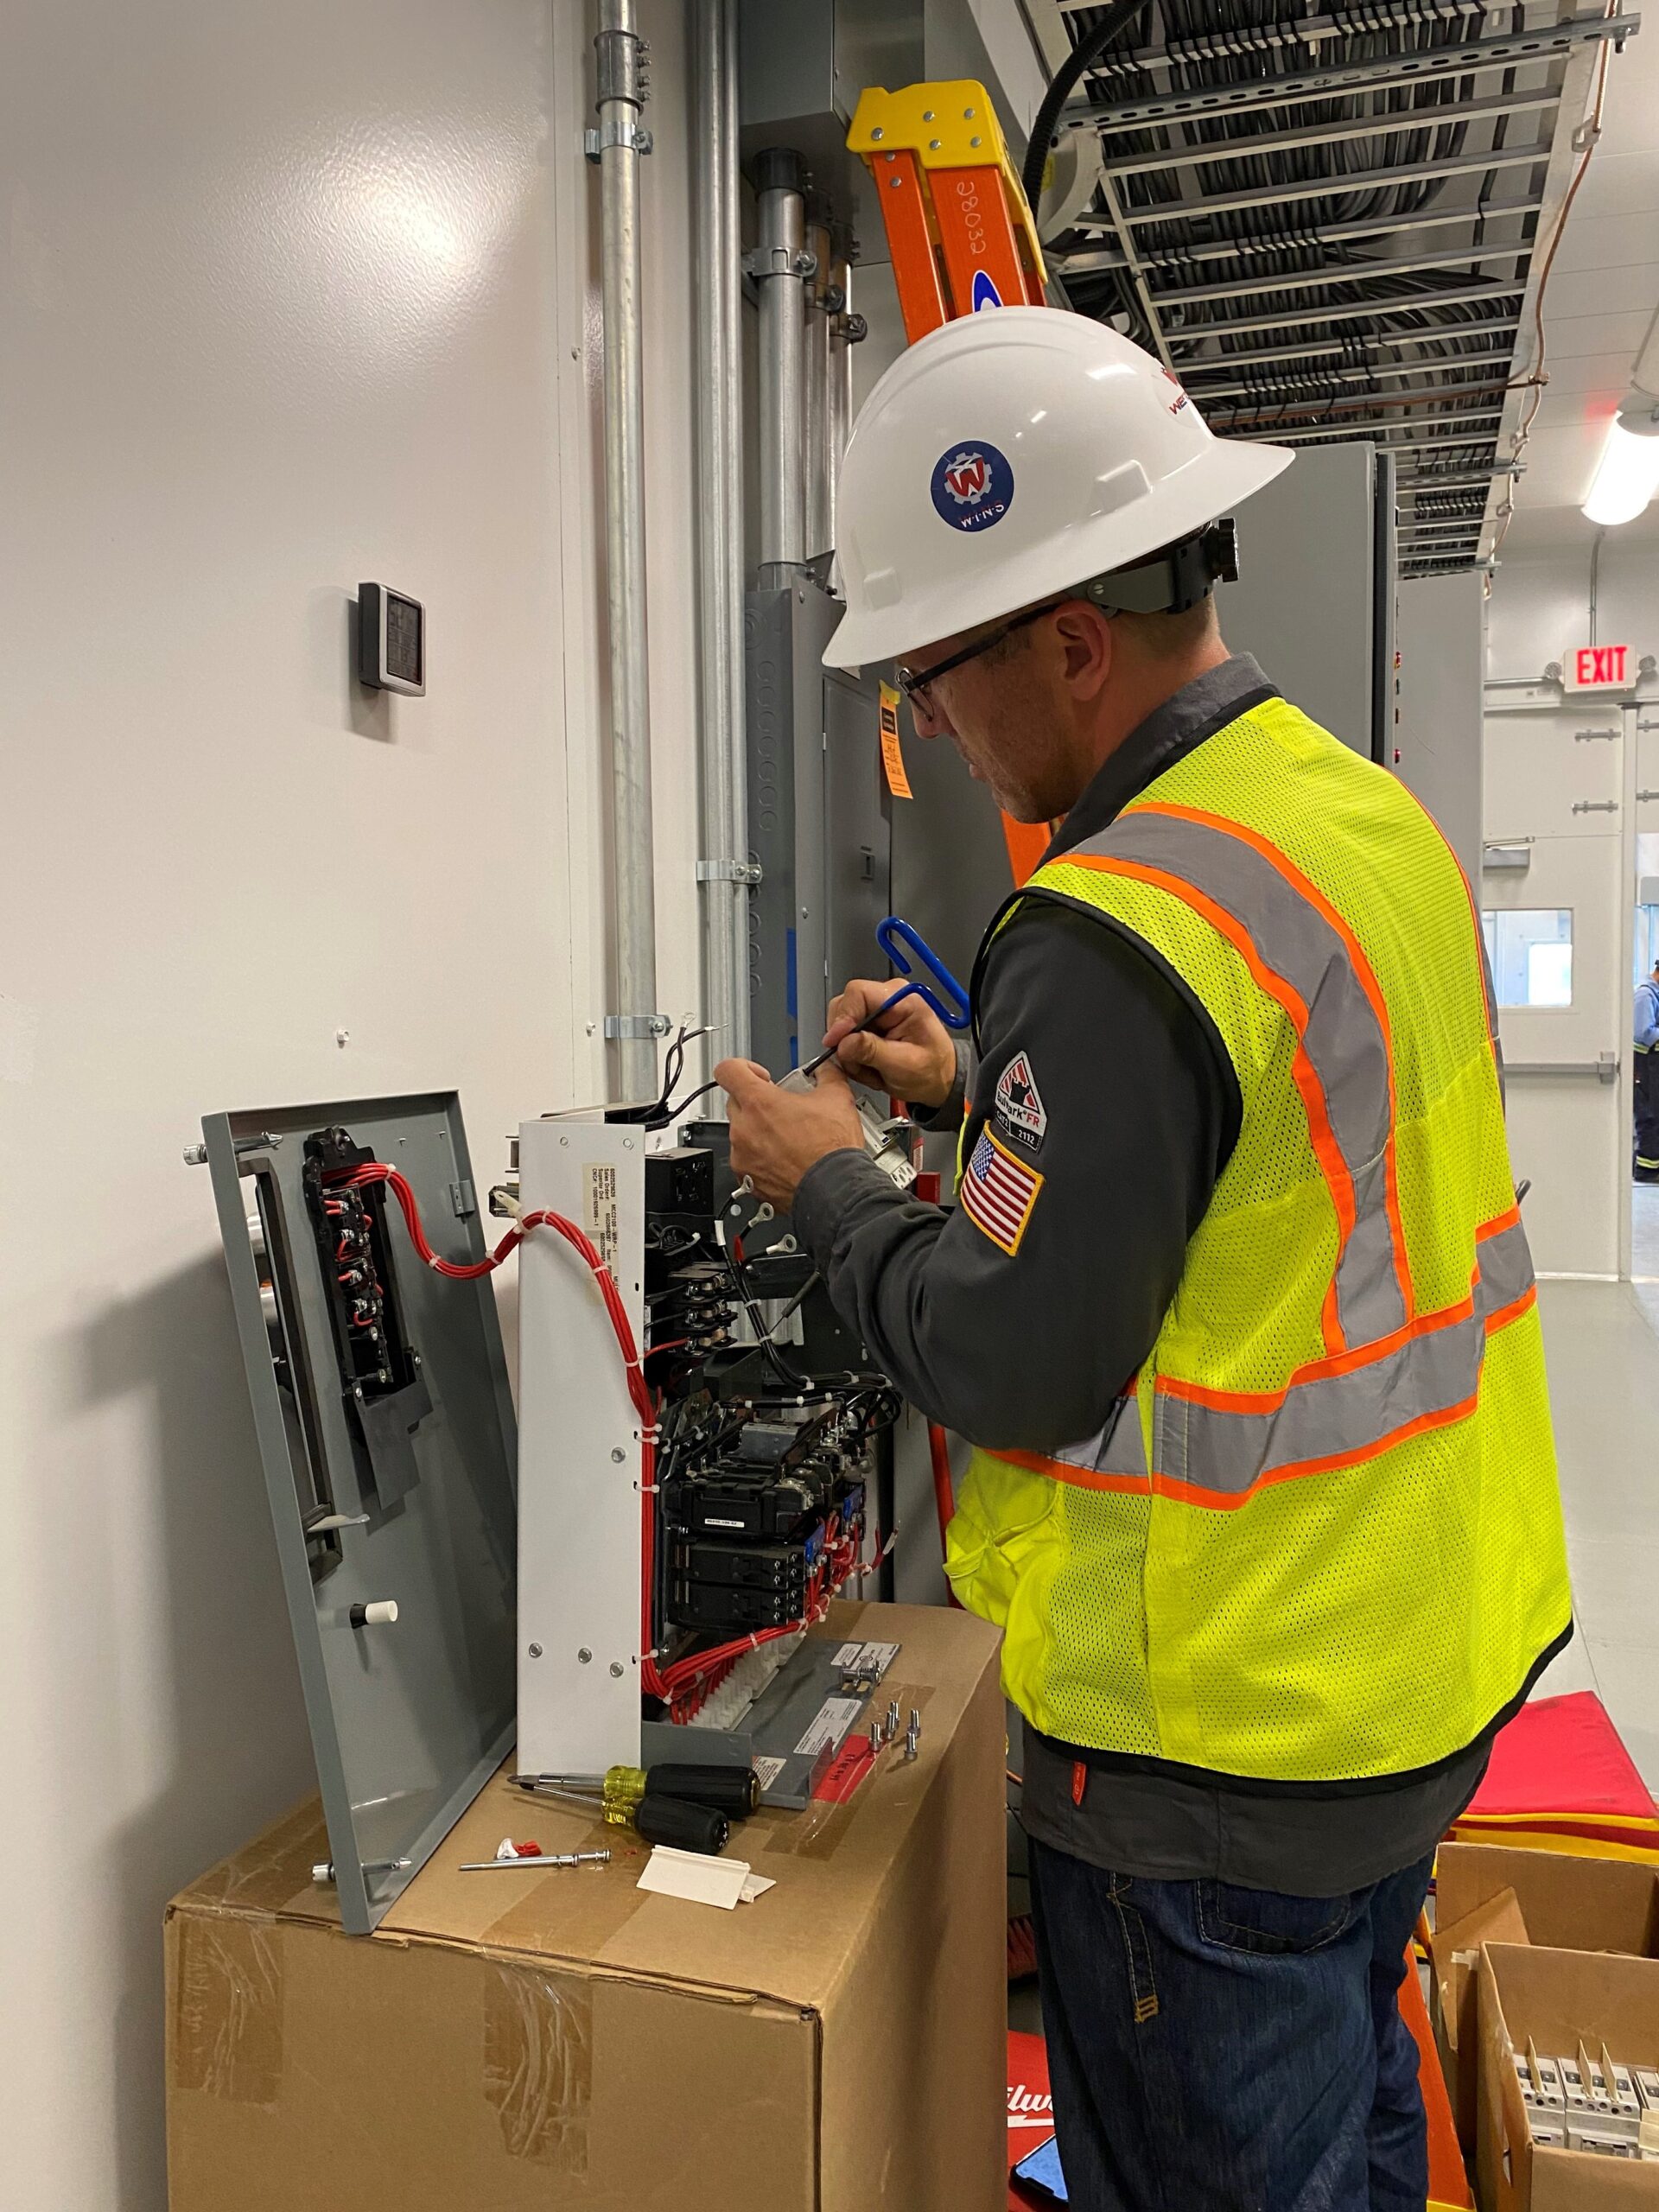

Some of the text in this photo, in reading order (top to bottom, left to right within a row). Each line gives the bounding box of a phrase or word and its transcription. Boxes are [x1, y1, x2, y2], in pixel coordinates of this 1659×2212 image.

[957, 181, 986, 255] 28032
[1577, 646, 1627, 684] EXIT
[1018, 1129, 1035, 1145] 2112
